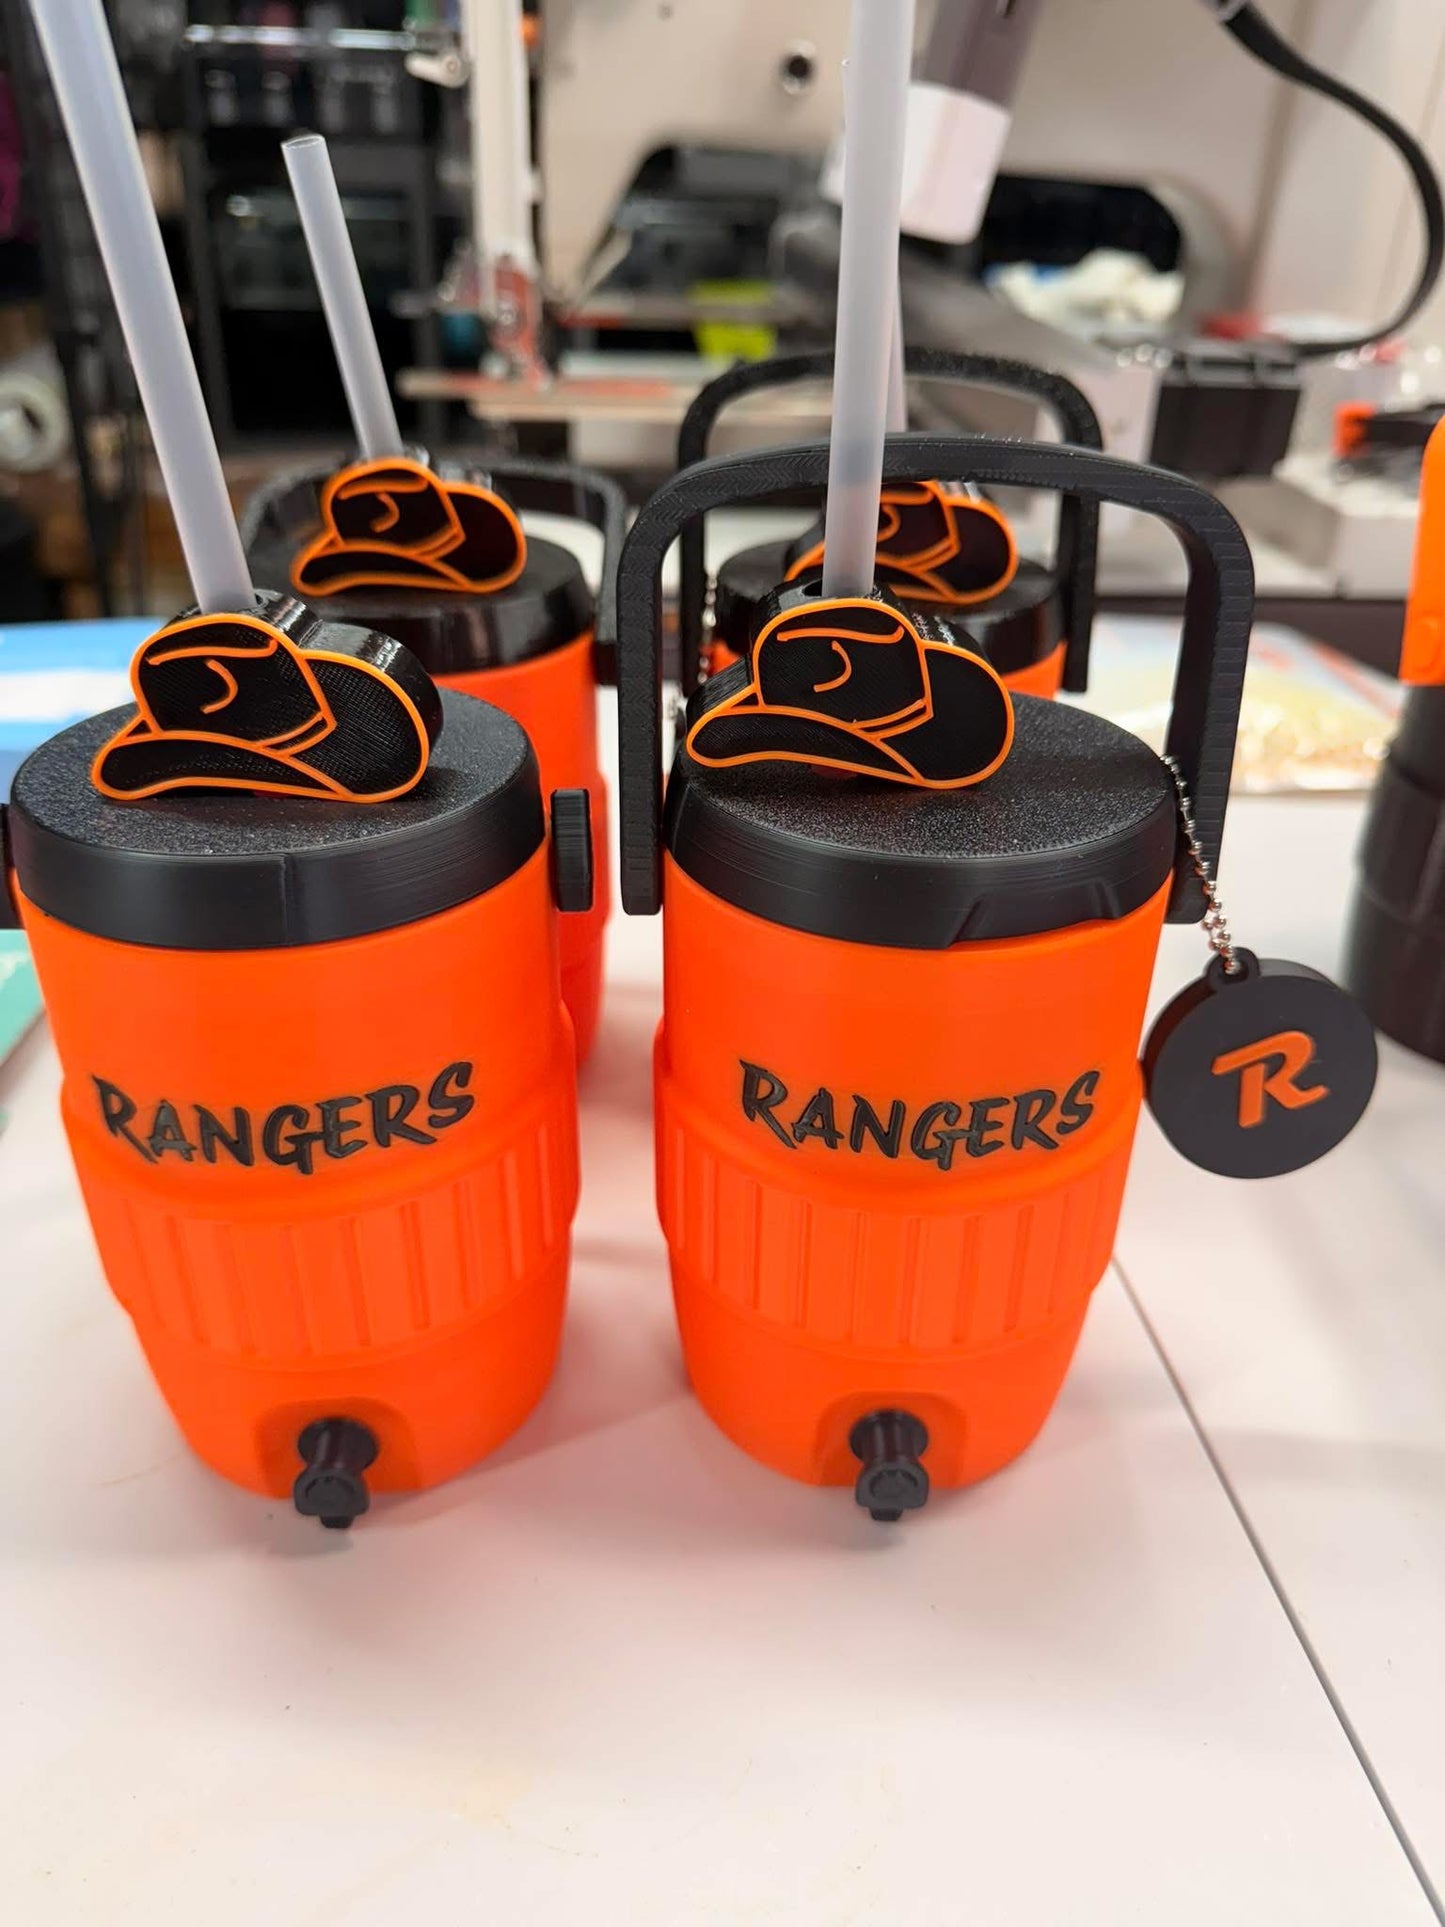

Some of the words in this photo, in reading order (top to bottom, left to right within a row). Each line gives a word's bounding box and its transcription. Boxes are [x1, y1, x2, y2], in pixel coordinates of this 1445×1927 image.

[91, 1061, 475, 1175] RANGERS
[739, 1059, 1101, 1171] RANGERS
[1211, 1030, 1330, 1129] R
